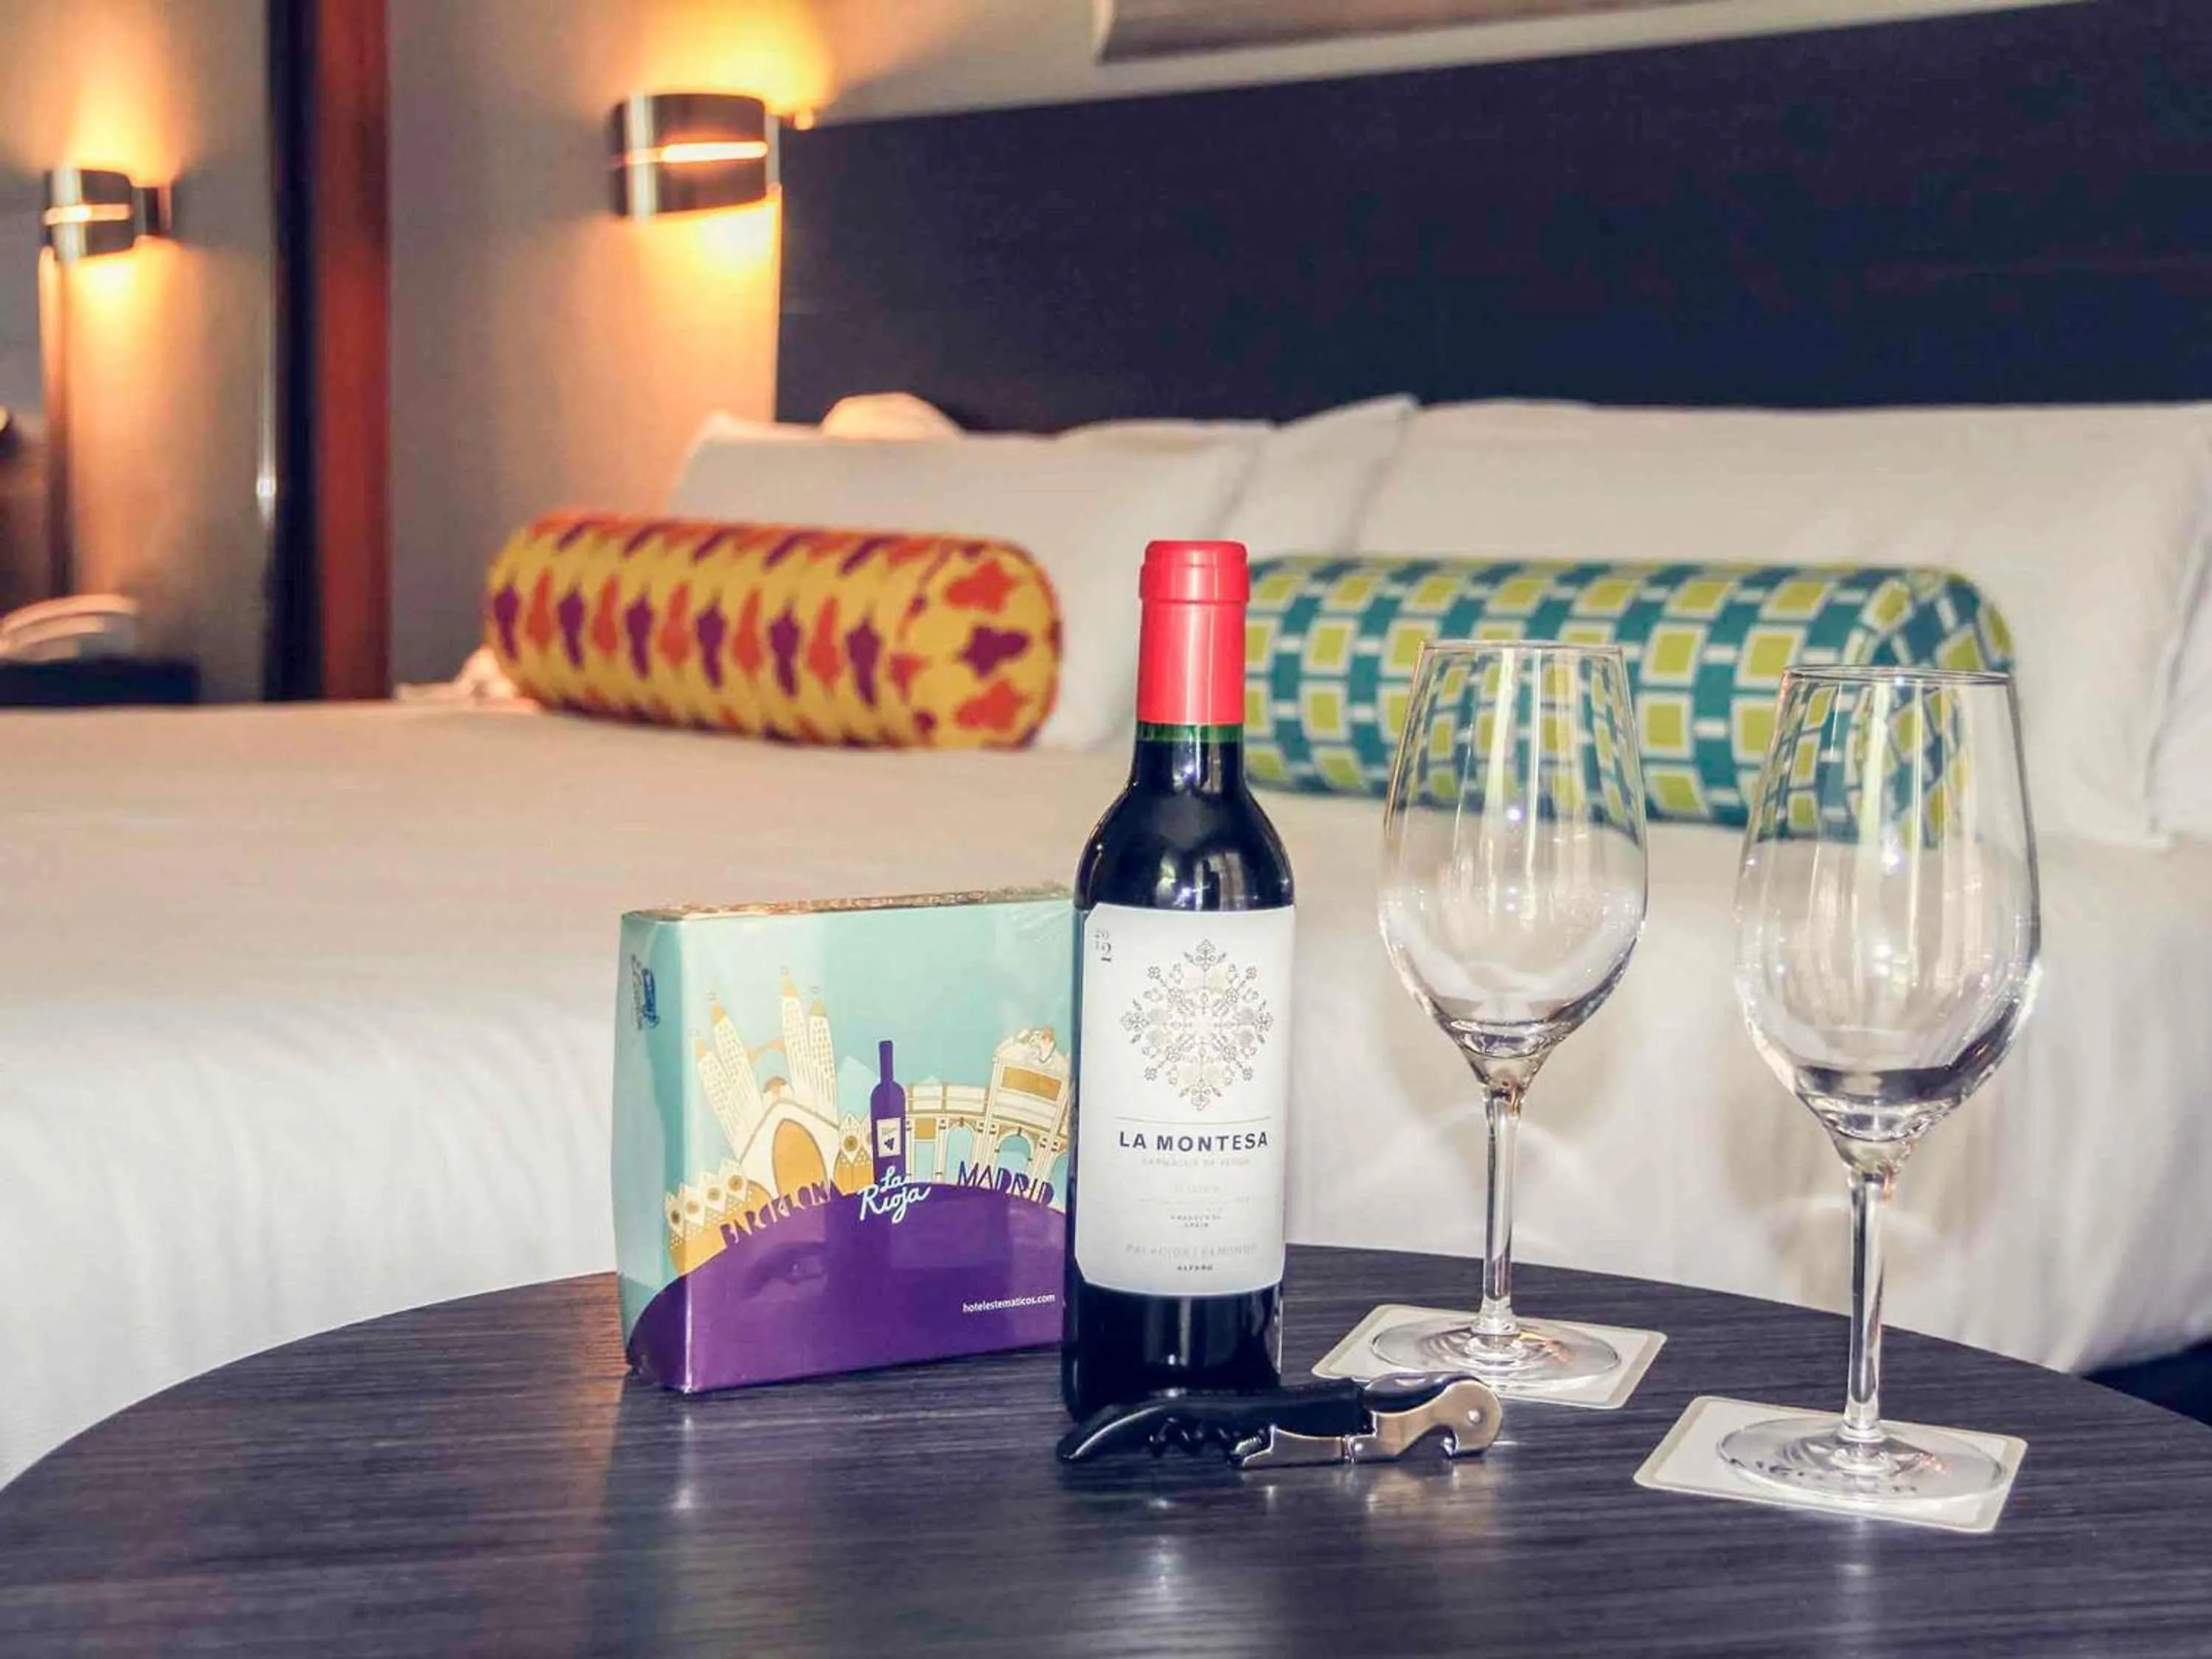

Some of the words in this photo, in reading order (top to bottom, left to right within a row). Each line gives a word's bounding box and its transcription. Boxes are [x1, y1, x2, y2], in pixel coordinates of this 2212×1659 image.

[1119, 1131, 1147, 1149] LA
[1156, 1132, 1269, 1152] MONTESA
[880, 1165, 913, 1193] La
[958, 1160, 1055, 1206] MADRID
[720, 1179, 845, 1248] BARCELONA
[857, 1183, 932, 1223] Rioja
[961, 1292, 1056, 1313] hotelestematicos.com
